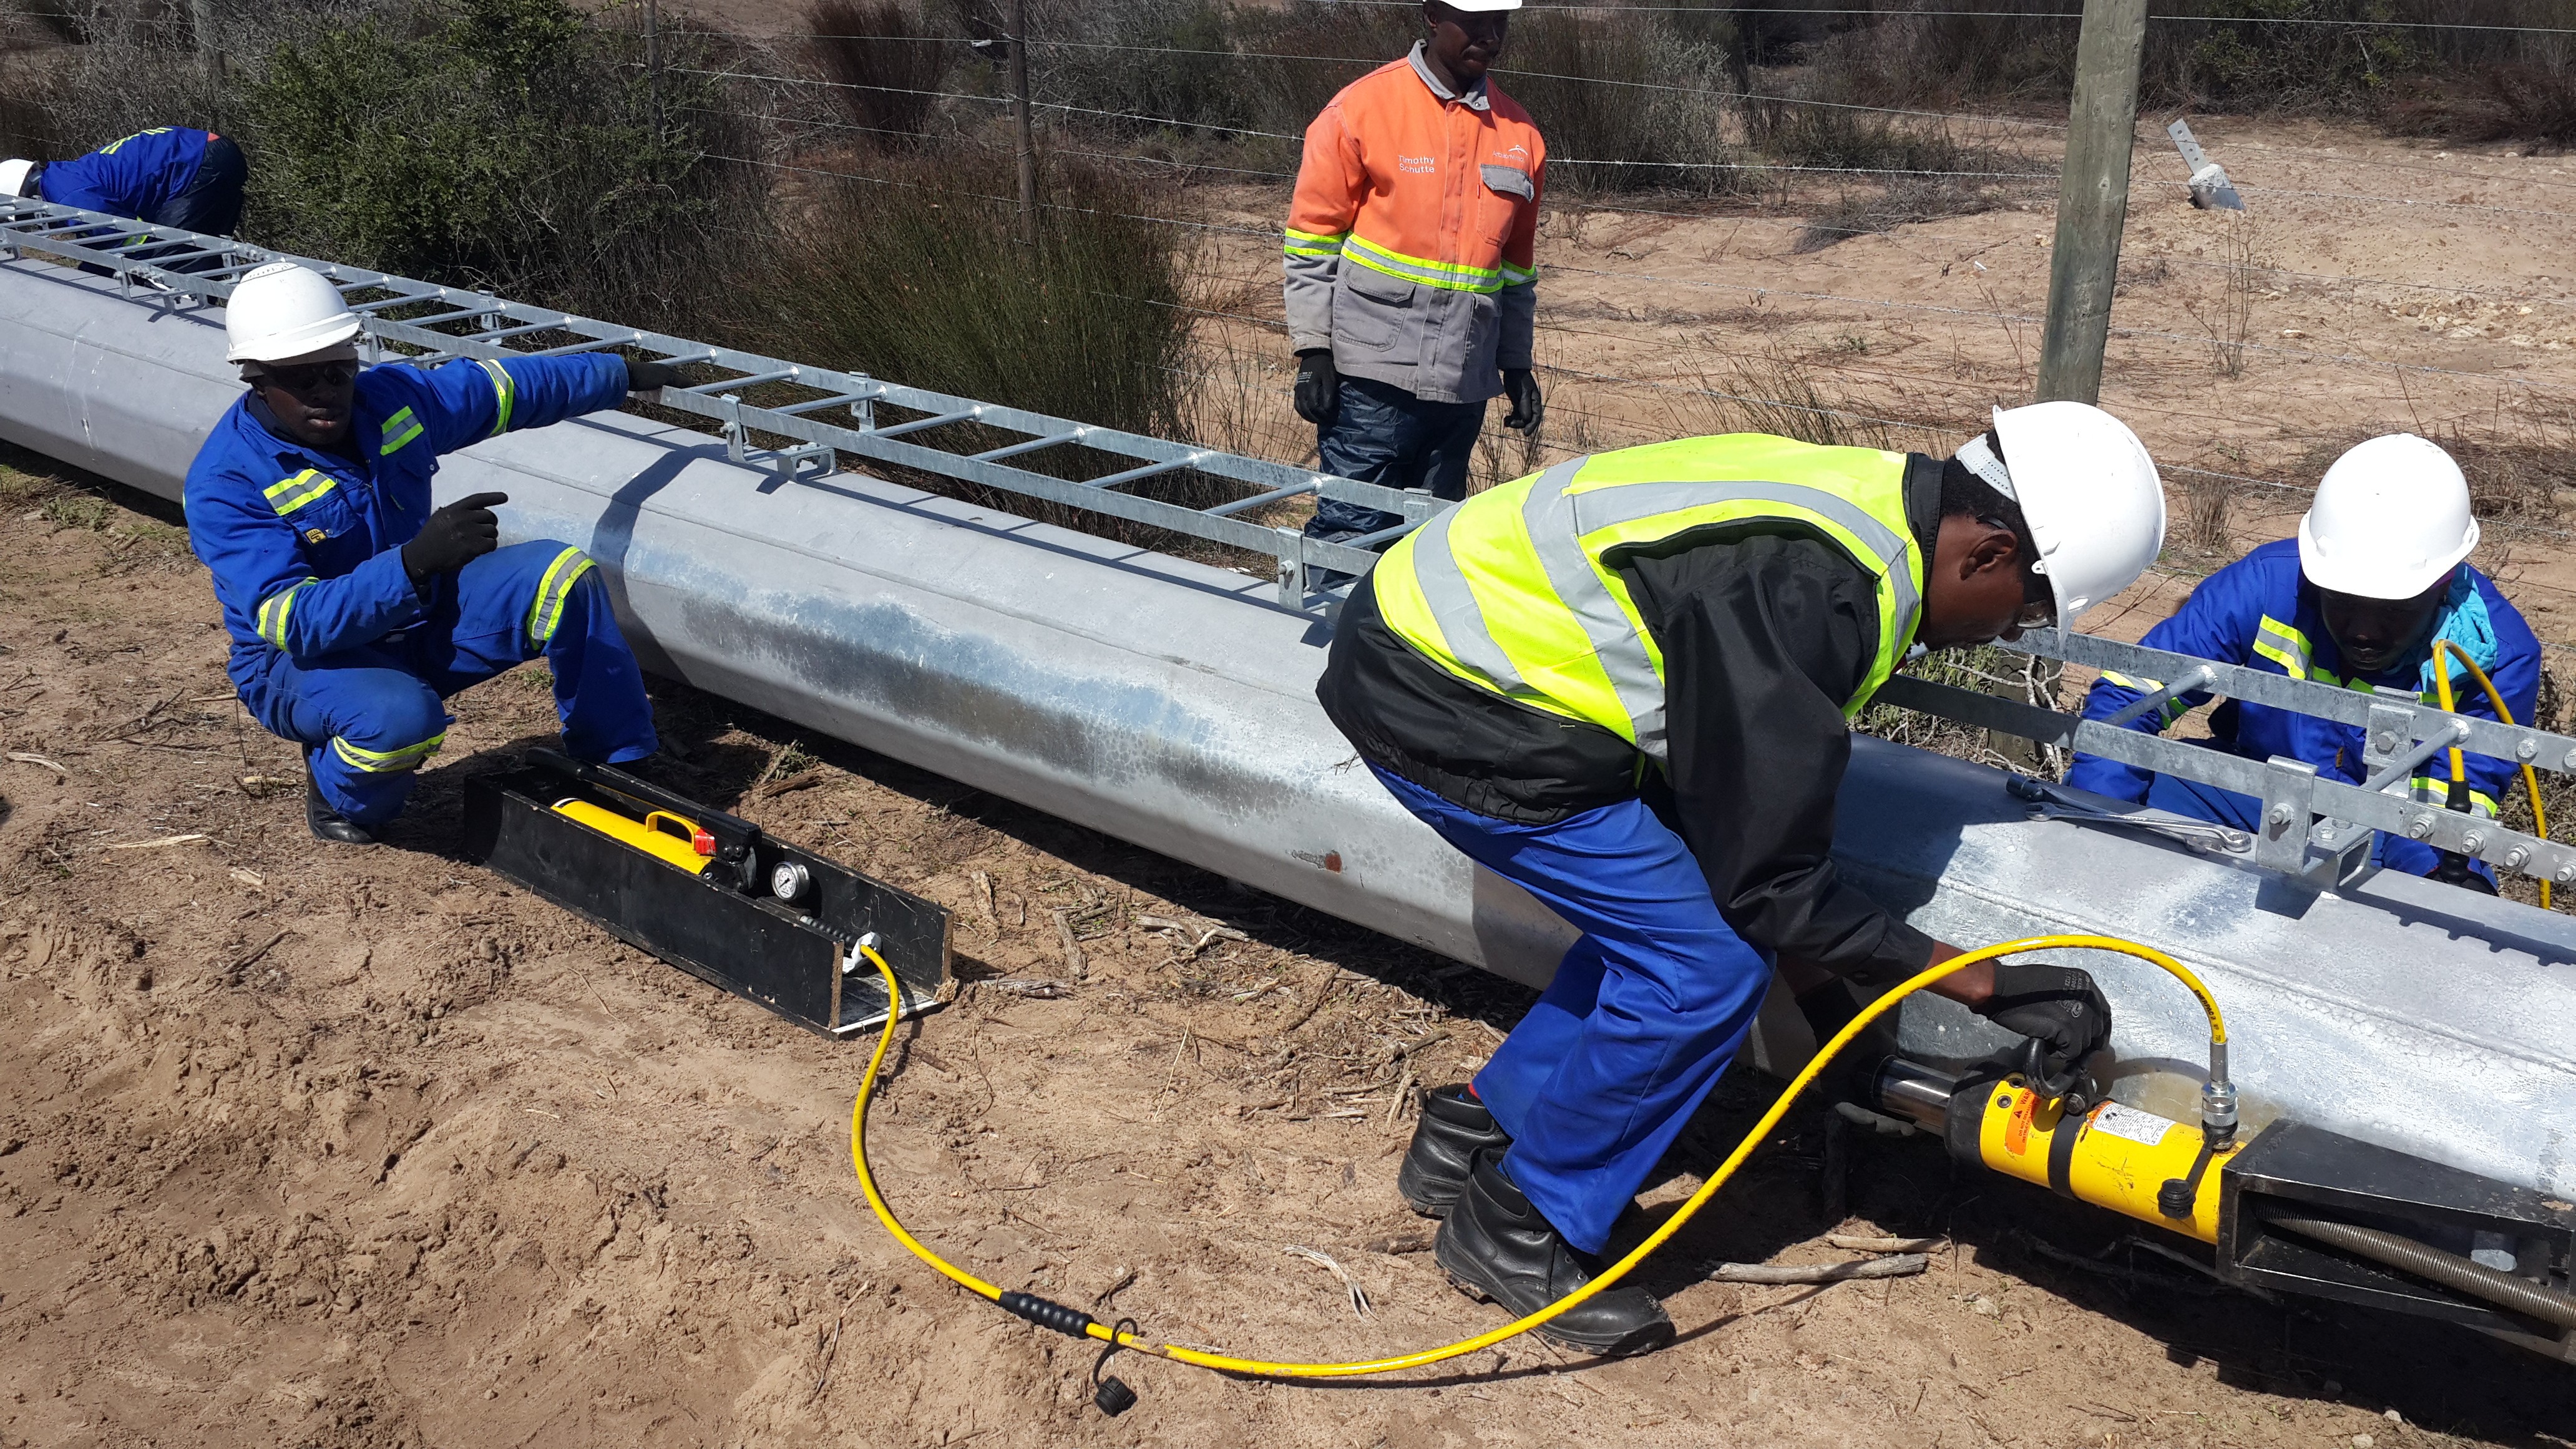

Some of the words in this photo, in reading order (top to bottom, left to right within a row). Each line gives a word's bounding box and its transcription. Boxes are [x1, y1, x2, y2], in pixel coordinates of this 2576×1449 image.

[1398, 155, 1435, 165] Timothy
[1399, 162, 1435, 173] Schutte
[2019, 1090, 2032, 1105] WAR
